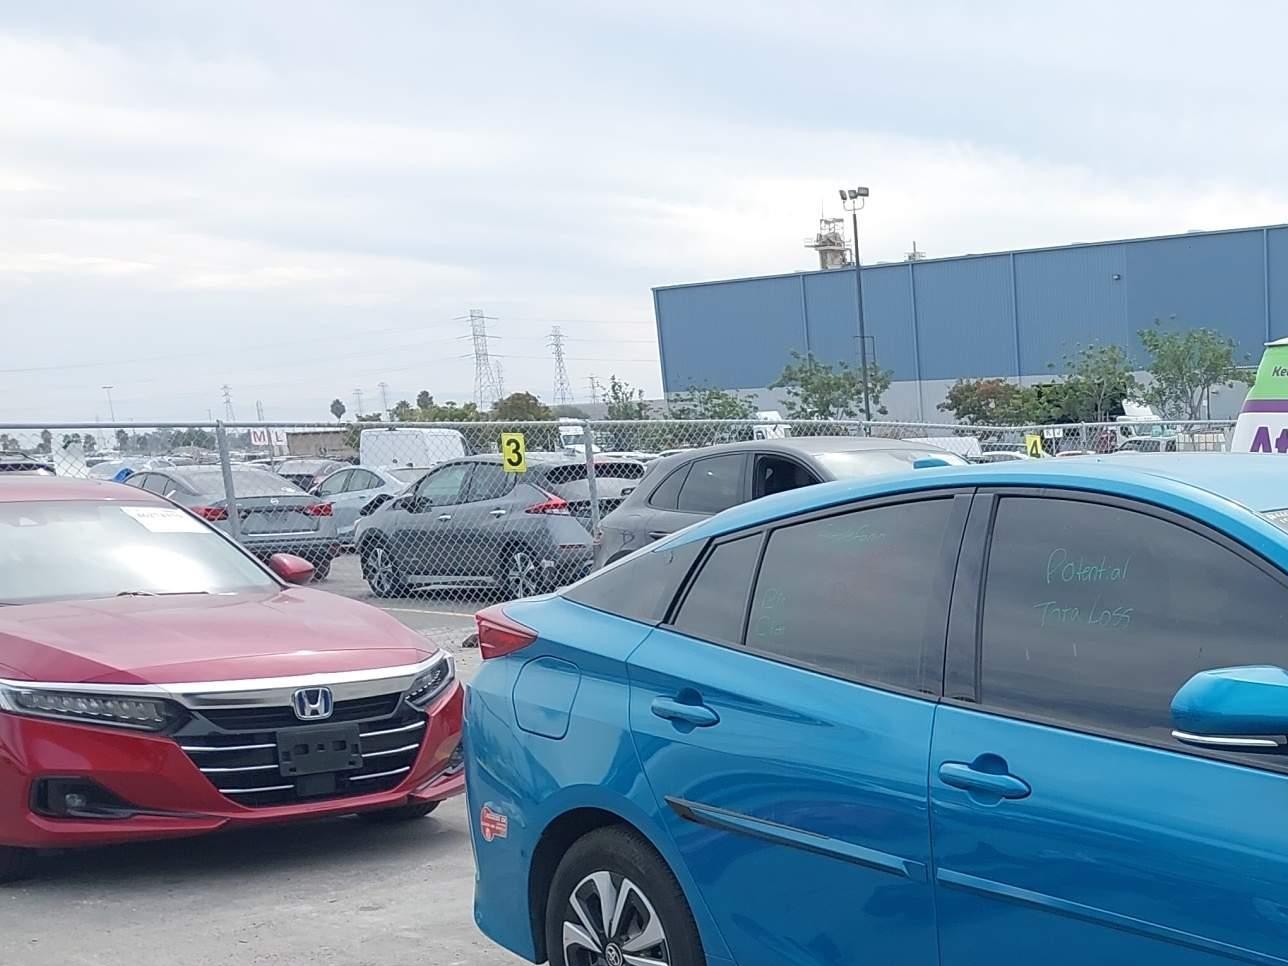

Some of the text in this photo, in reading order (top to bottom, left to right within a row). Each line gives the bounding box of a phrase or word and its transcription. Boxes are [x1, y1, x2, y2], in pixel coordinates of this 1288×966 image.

[506, 438, 523, 467] 3
[1030, 439, 1041, 458] 4
[1047, 548, 1130, 584] Potential
